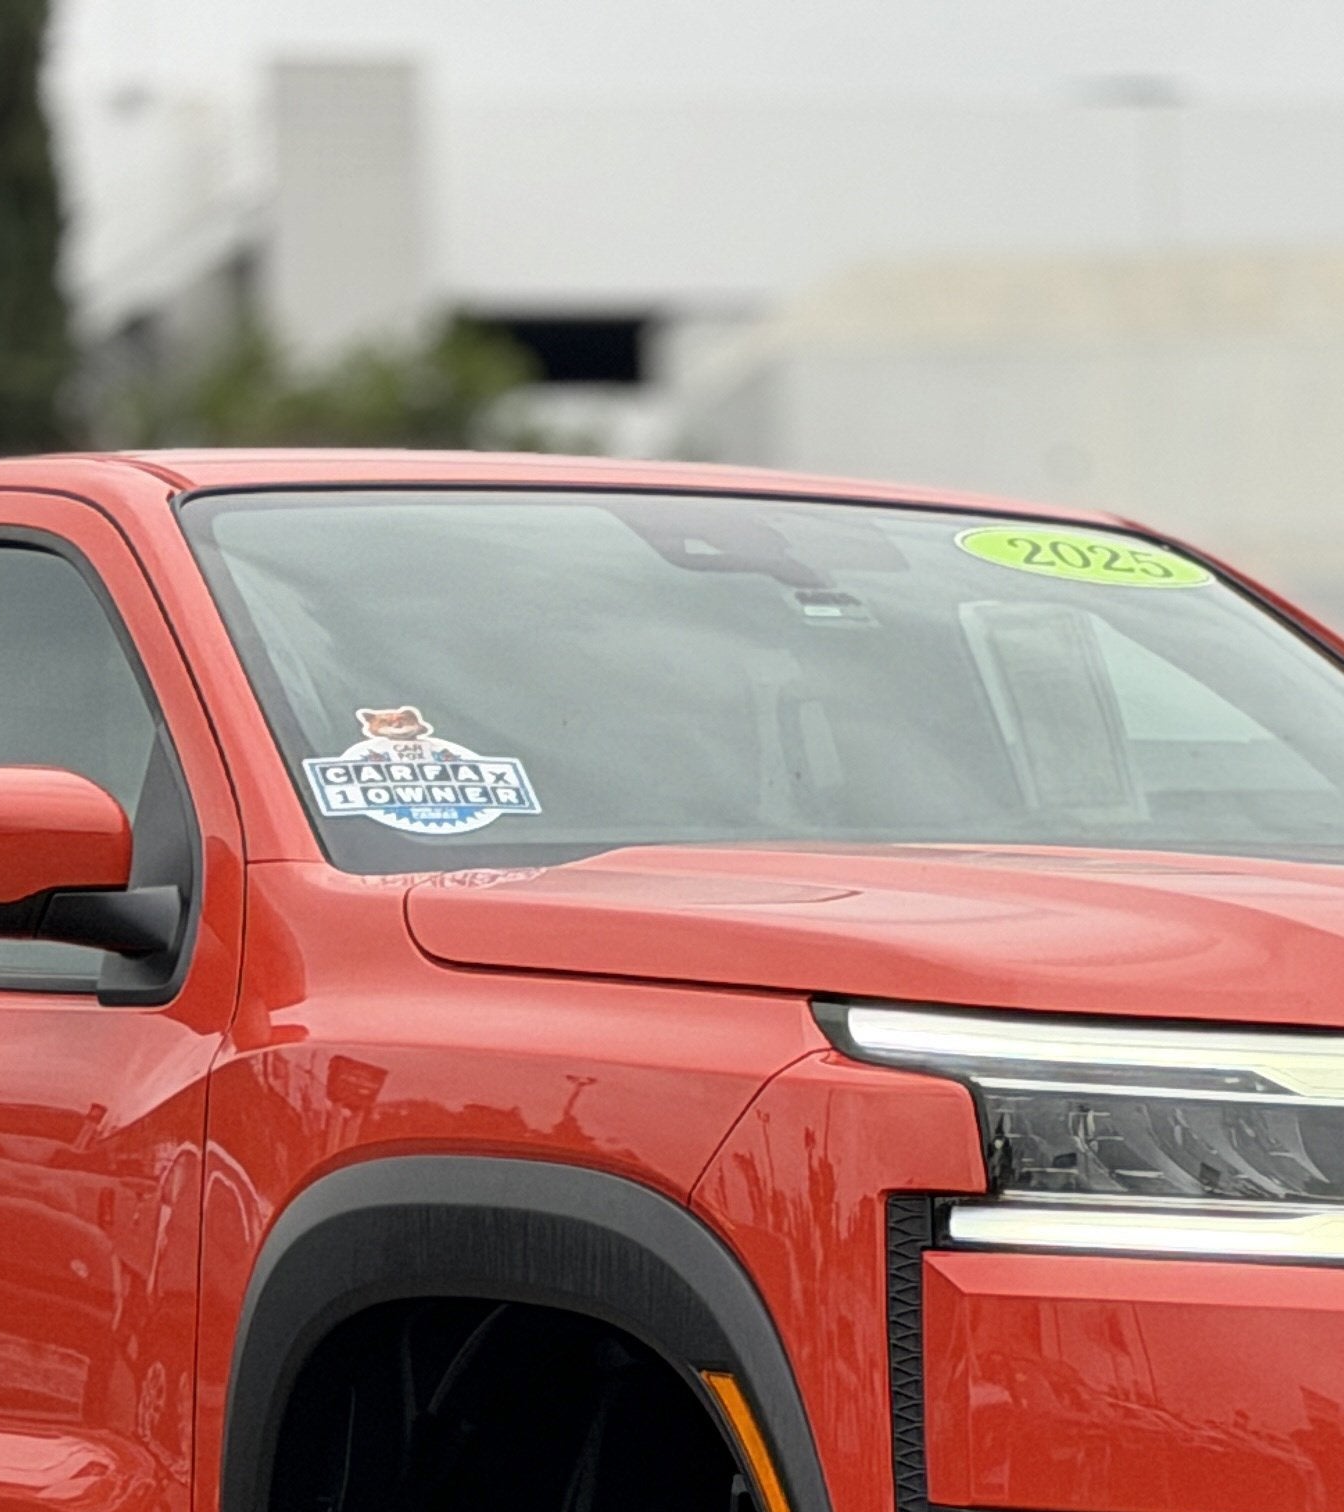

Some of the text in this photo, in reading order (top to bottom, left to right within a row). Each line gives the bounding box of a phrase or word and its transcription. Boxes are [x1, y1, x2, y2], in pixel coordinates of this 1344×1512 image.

[1006, 537, 1174, 578] 2025
[324, 764, 512, 785] CARFAX
[336, 785, 521, 805] 1 OWNER
